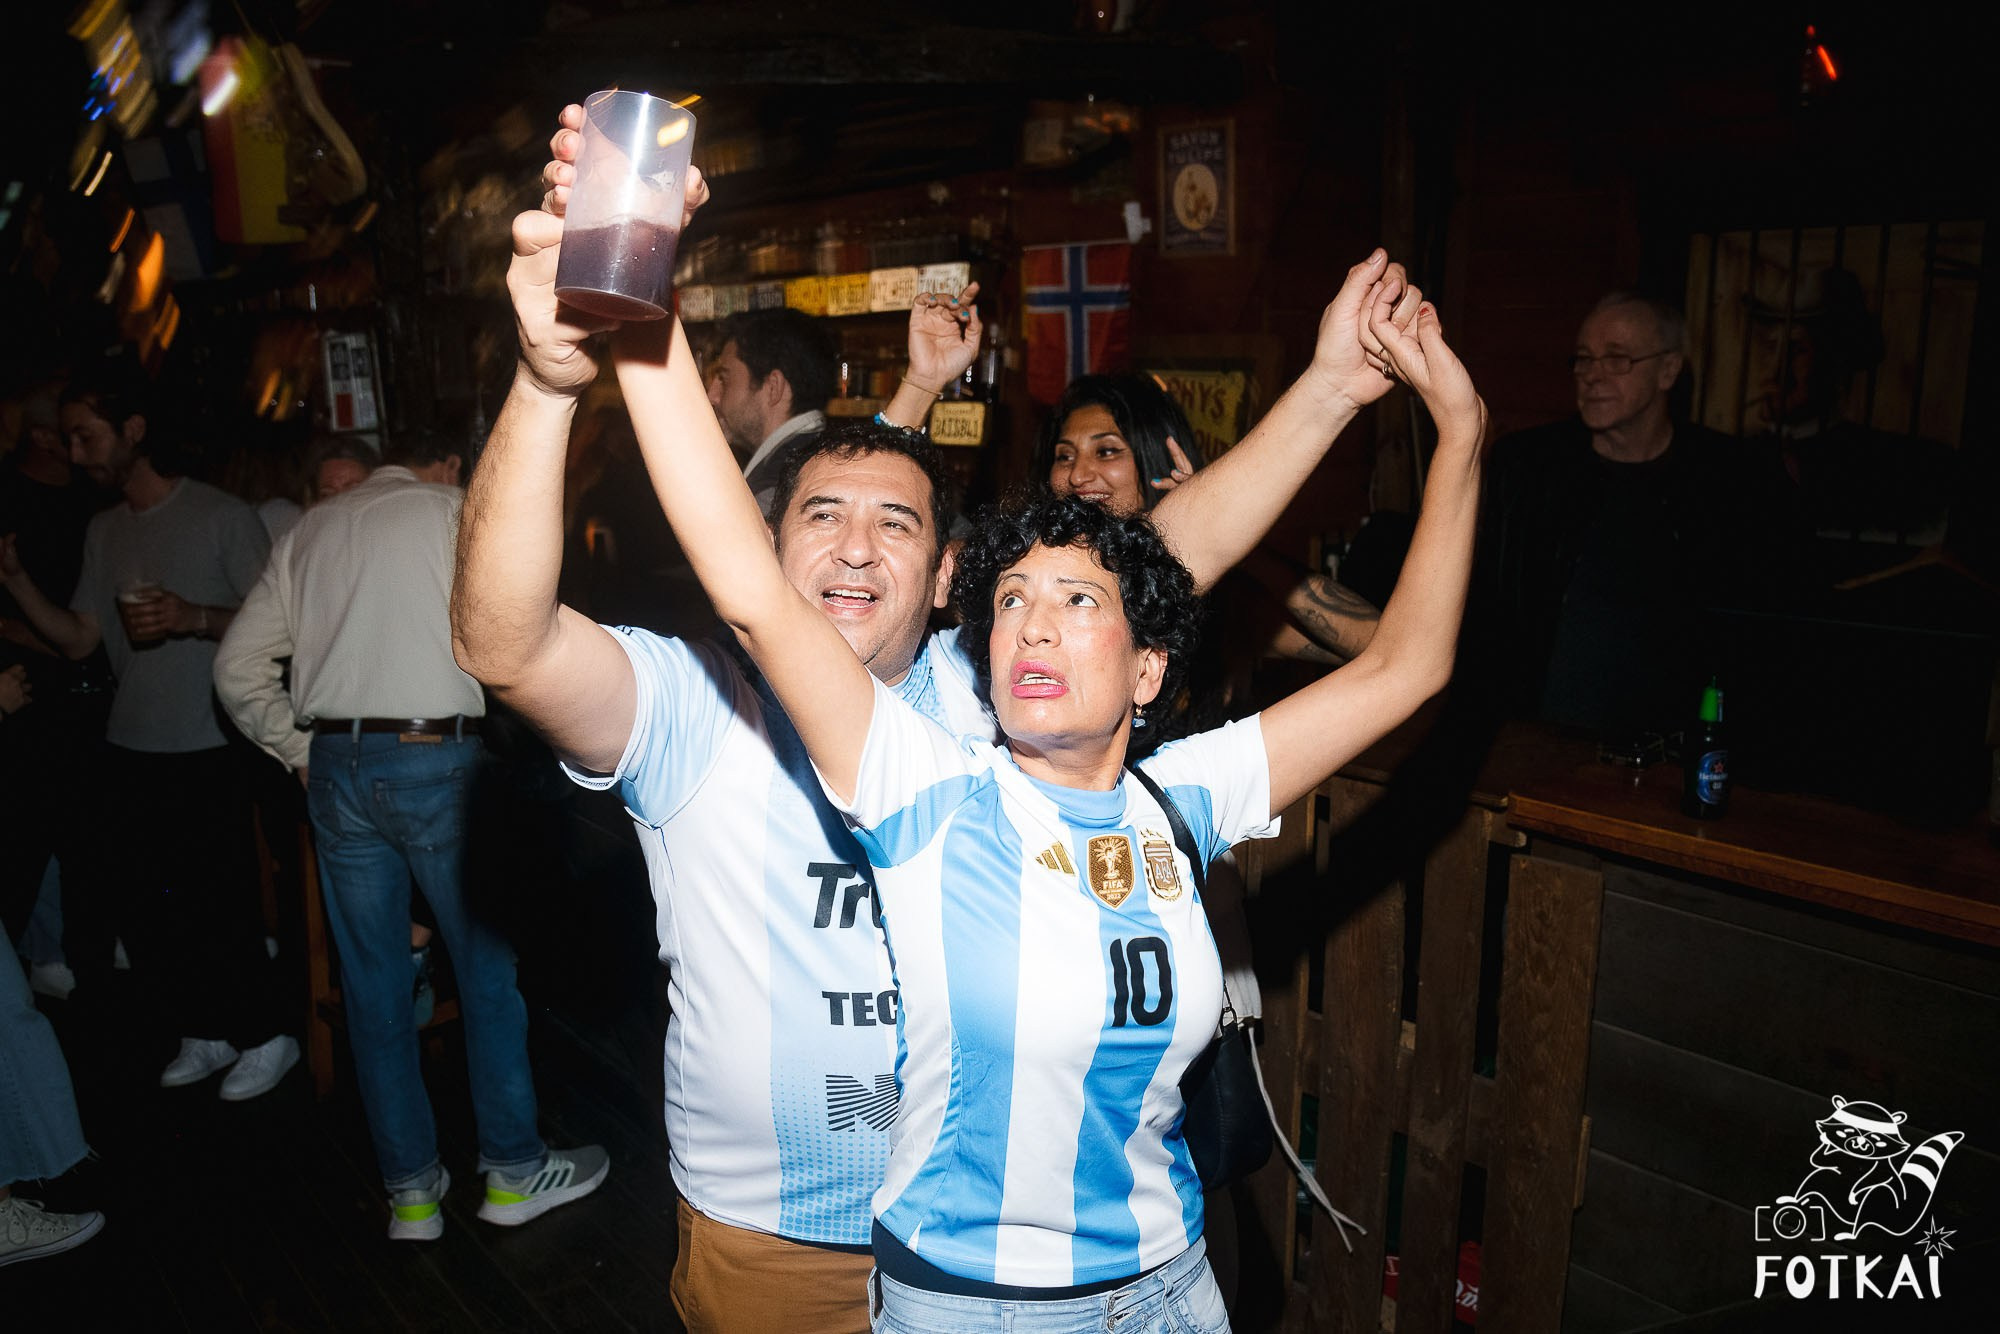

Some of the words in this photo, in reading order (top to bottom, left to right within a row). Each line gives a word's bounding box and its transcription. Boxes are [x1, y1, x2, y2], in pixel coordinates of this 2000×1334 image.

[1102, 879, 1124, 890] FIFA
[1109, 936, 1174, 1028] 10
[821, 990, 898, 1027] TEC
